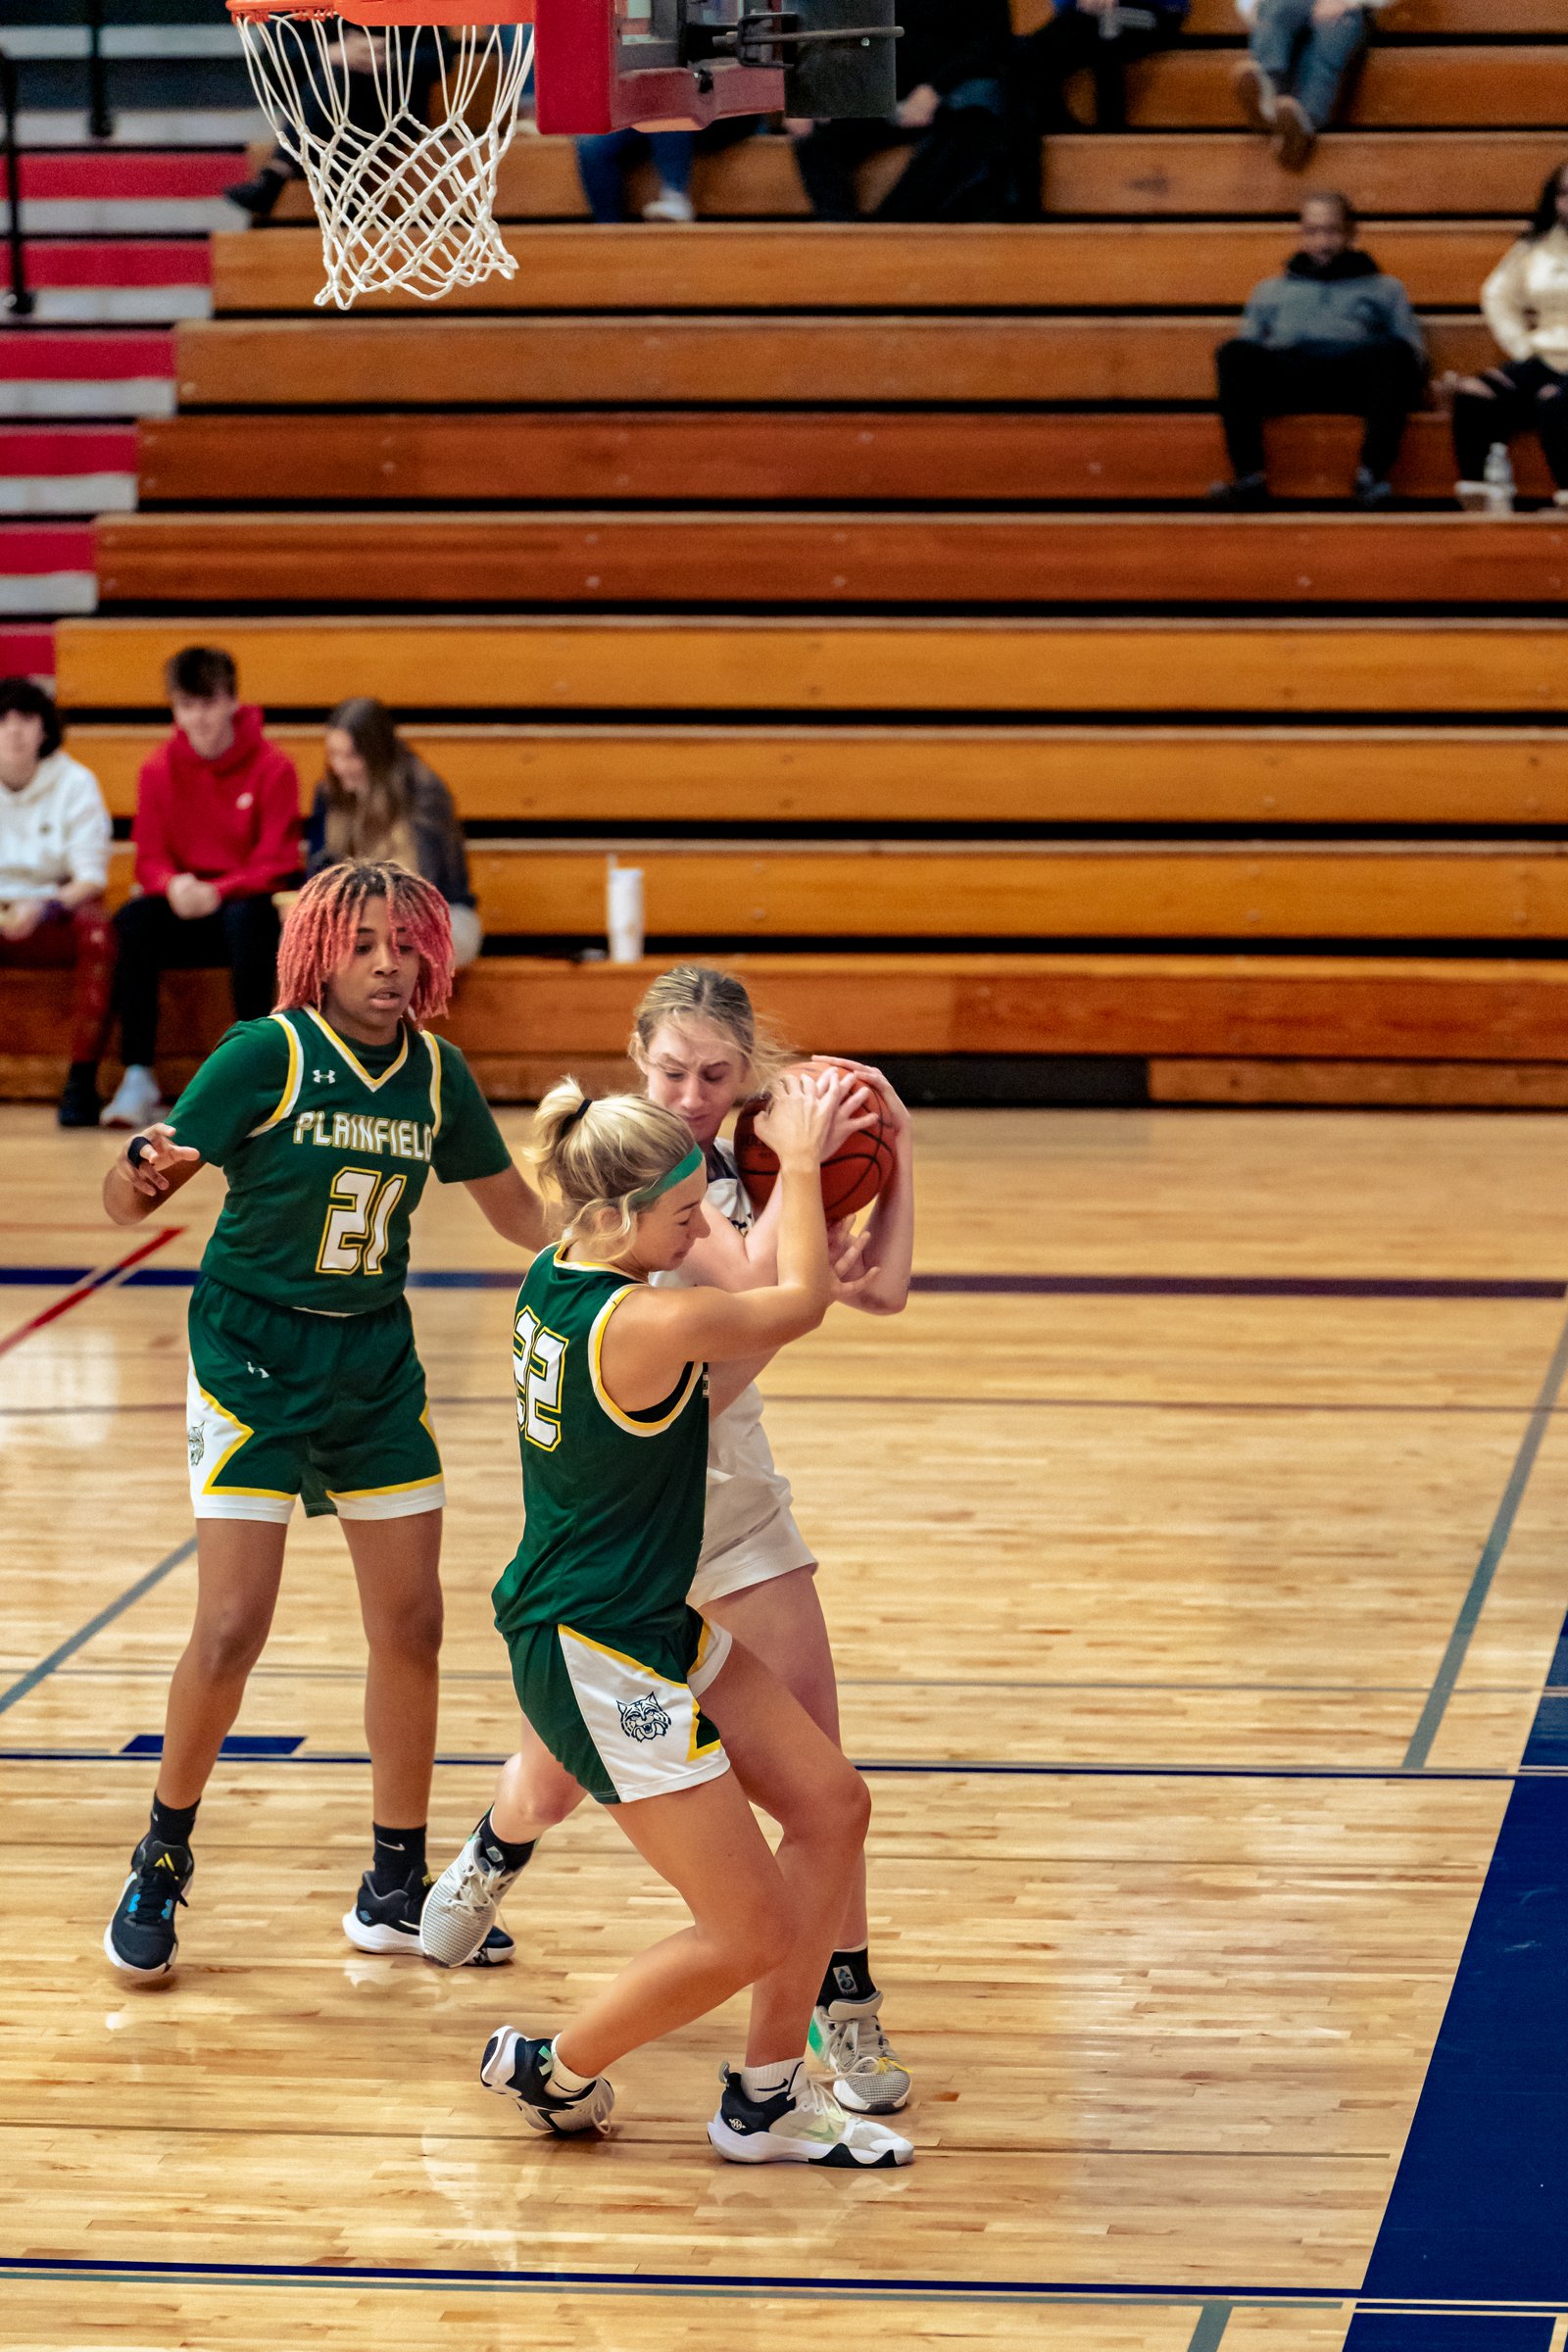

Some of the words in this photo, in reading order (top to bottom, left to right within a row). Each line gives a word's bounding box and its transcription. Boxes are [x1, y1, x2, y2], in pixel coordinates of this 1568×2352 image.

[293, 1110, 432, 1163] PLAINFIELD
[315, 1166, 407, 1276] 21
[513, 1304, 569, 1452] 22
